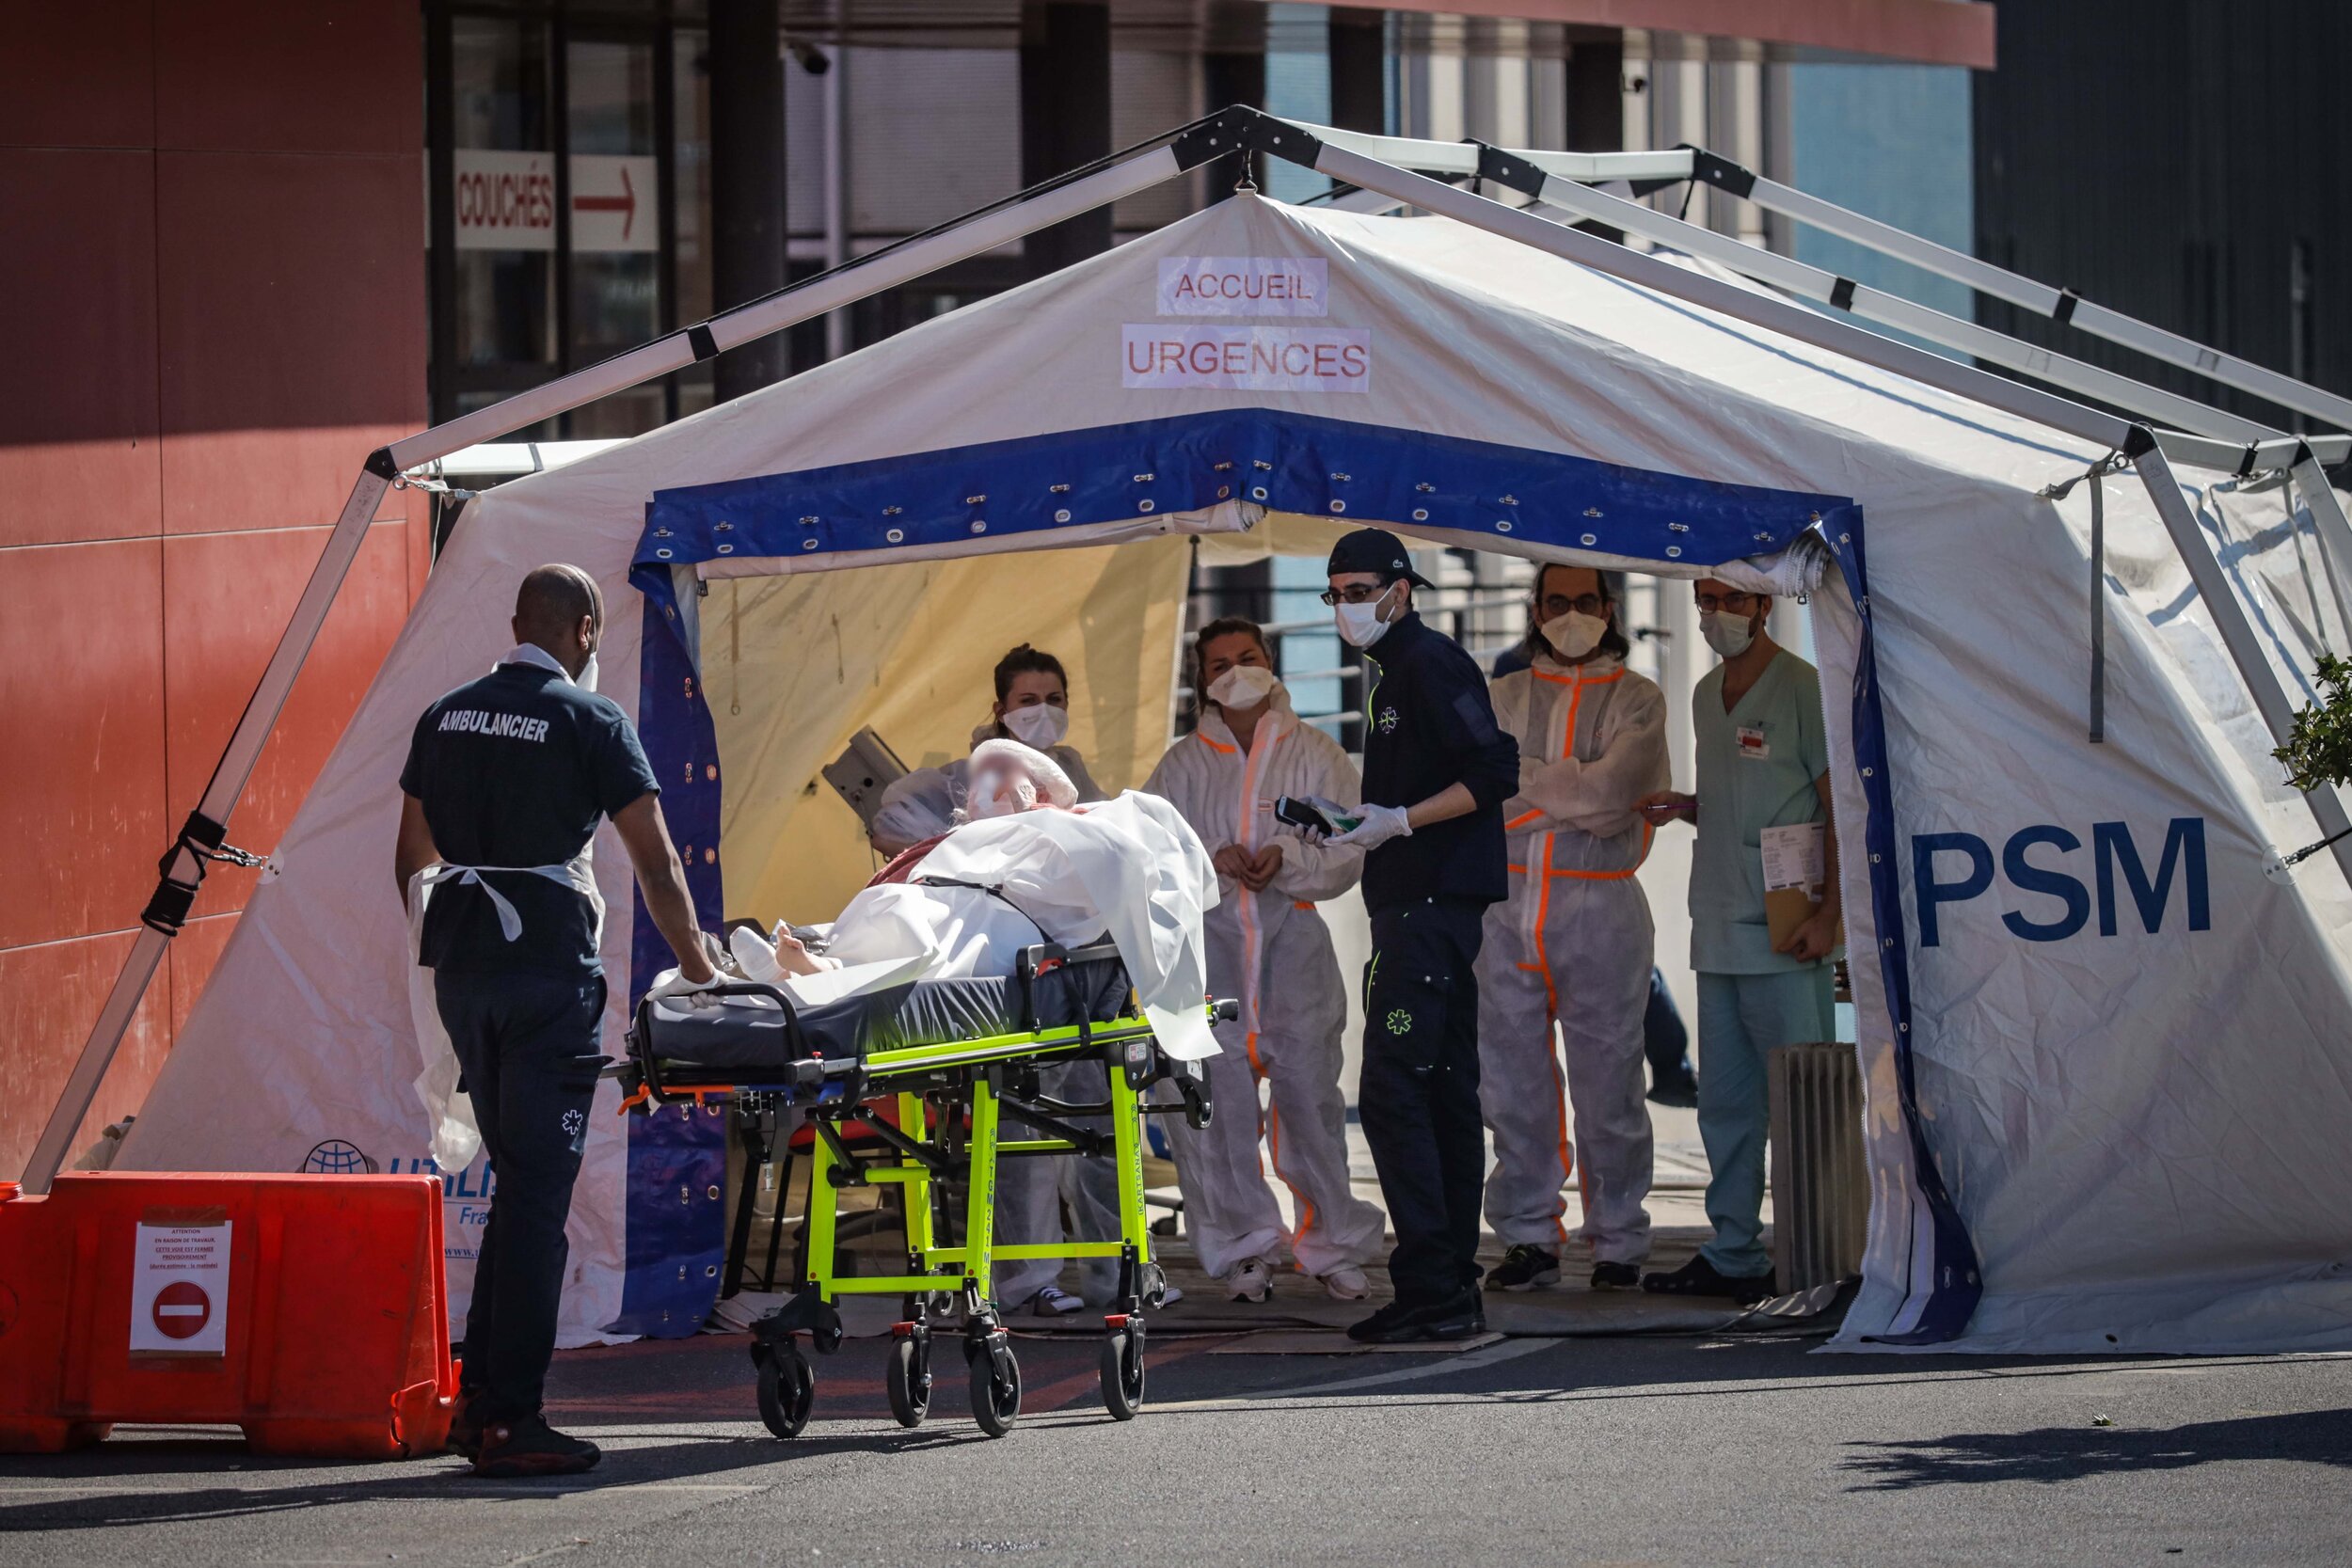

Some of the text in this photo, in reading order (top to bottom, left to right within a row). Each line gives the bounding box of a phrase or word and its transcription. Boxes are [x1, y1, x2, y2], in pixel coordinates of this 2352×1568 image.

[457, 159, 552, 228] COUCHÉS
[1175, 274, 1312, 300] ACCUEIL
[1128, 341, 1367, 377] URGENCES
[437, 710, 549, 743] AMBULANCIER
[1911, 816, 2211, 948] PSM
[390, 1158, 497, 1198] ILI
[459, 1207, 489, 1225] Fra
